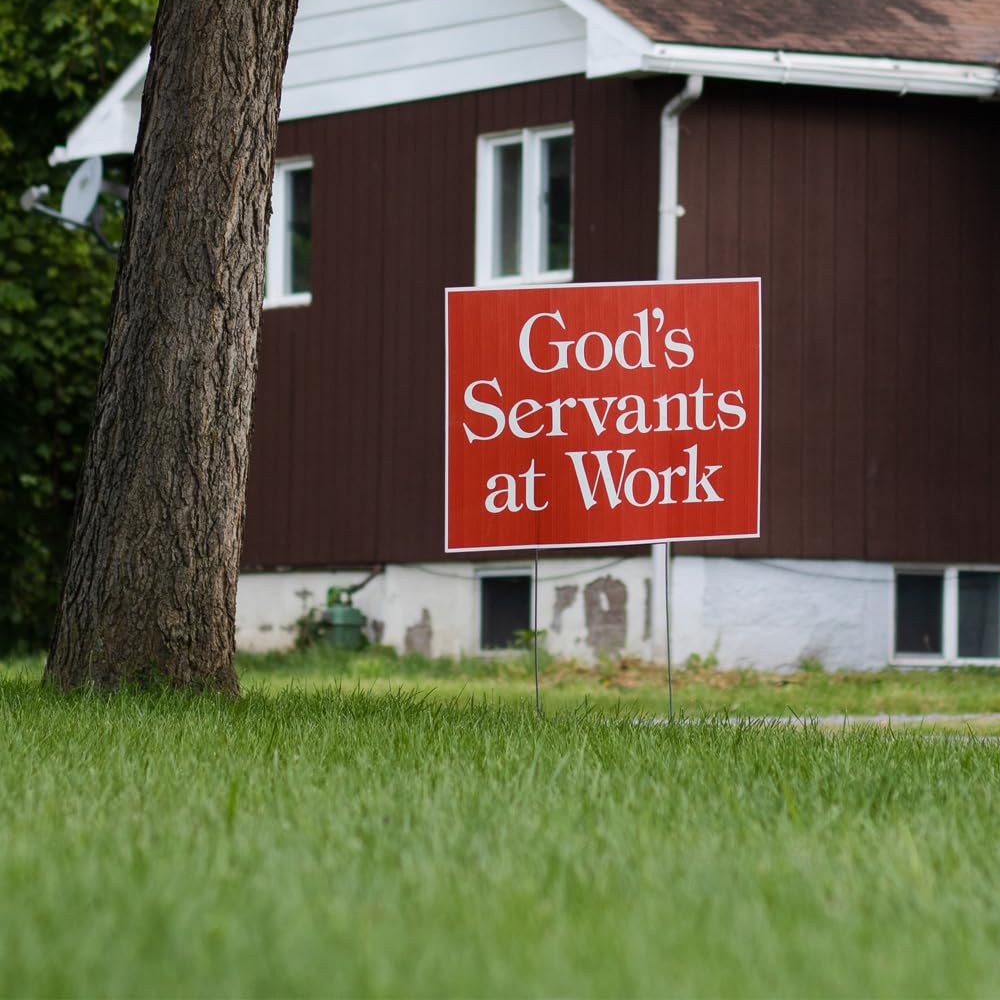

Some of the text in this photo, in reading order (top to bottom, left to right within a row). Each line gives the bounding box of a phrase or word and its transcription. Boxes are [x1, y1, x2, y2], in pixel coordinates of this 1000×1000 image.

[519, 307, 695, 373] God's
[462, 377, 747, 444] Servants
[484, 443, 725, 514] at Work
